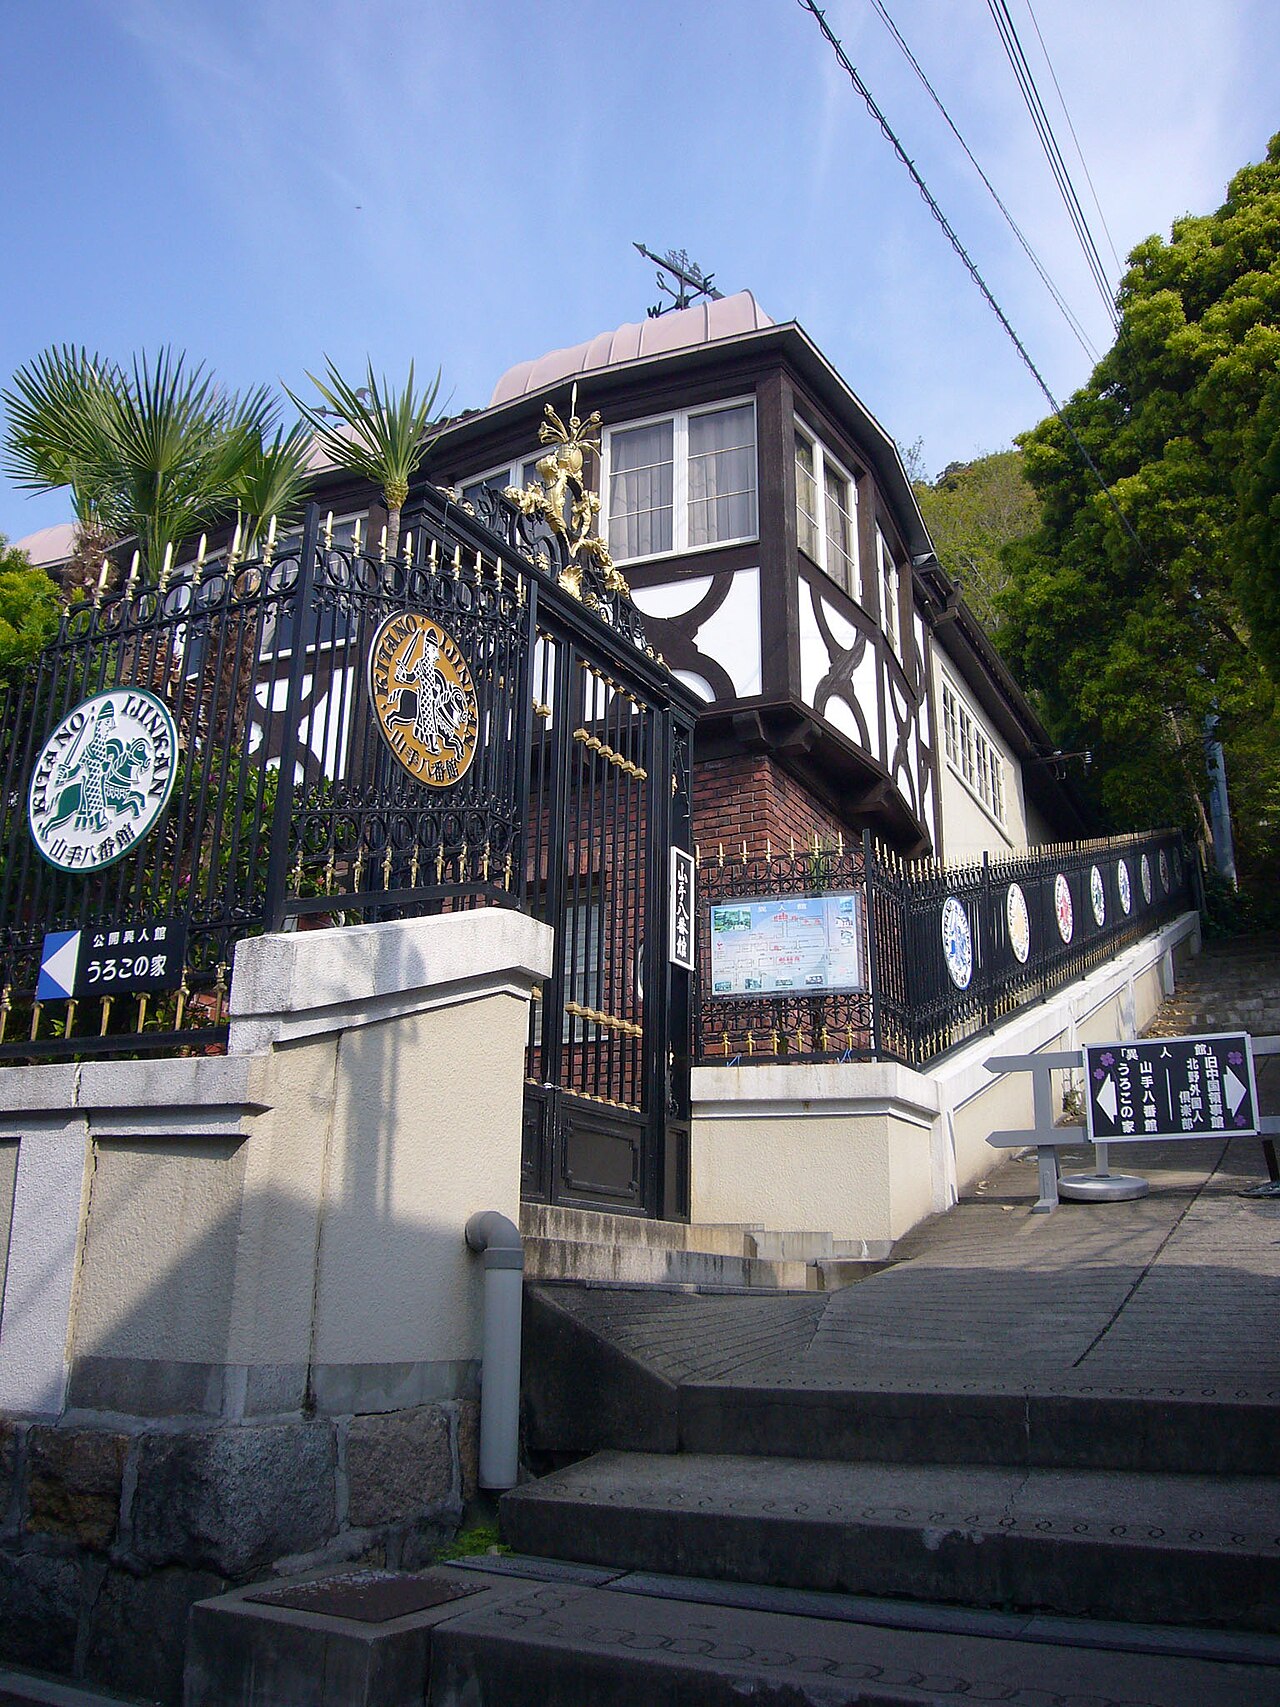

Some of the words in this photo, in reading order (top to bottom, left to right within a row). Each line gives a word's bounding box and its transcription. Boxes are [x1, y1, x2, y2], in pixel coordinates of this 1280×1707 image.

[647, 301, 662, 319] W
[120, 694, 171, 798] IJINKAN
[390, 729, 460, 783] 山手八番館
[49, 821, 136, 867] 山手八番館
[92, 925, 167, 948] 公開異人館
[87, 954, 167, 983] うろこの家
[1117, 1063, 1136, 1134] うろこの家
[1139, 1060, 1158, 1133] 山手八番館
[1204, 1056, 1224, 1129] 旧中国領事館
